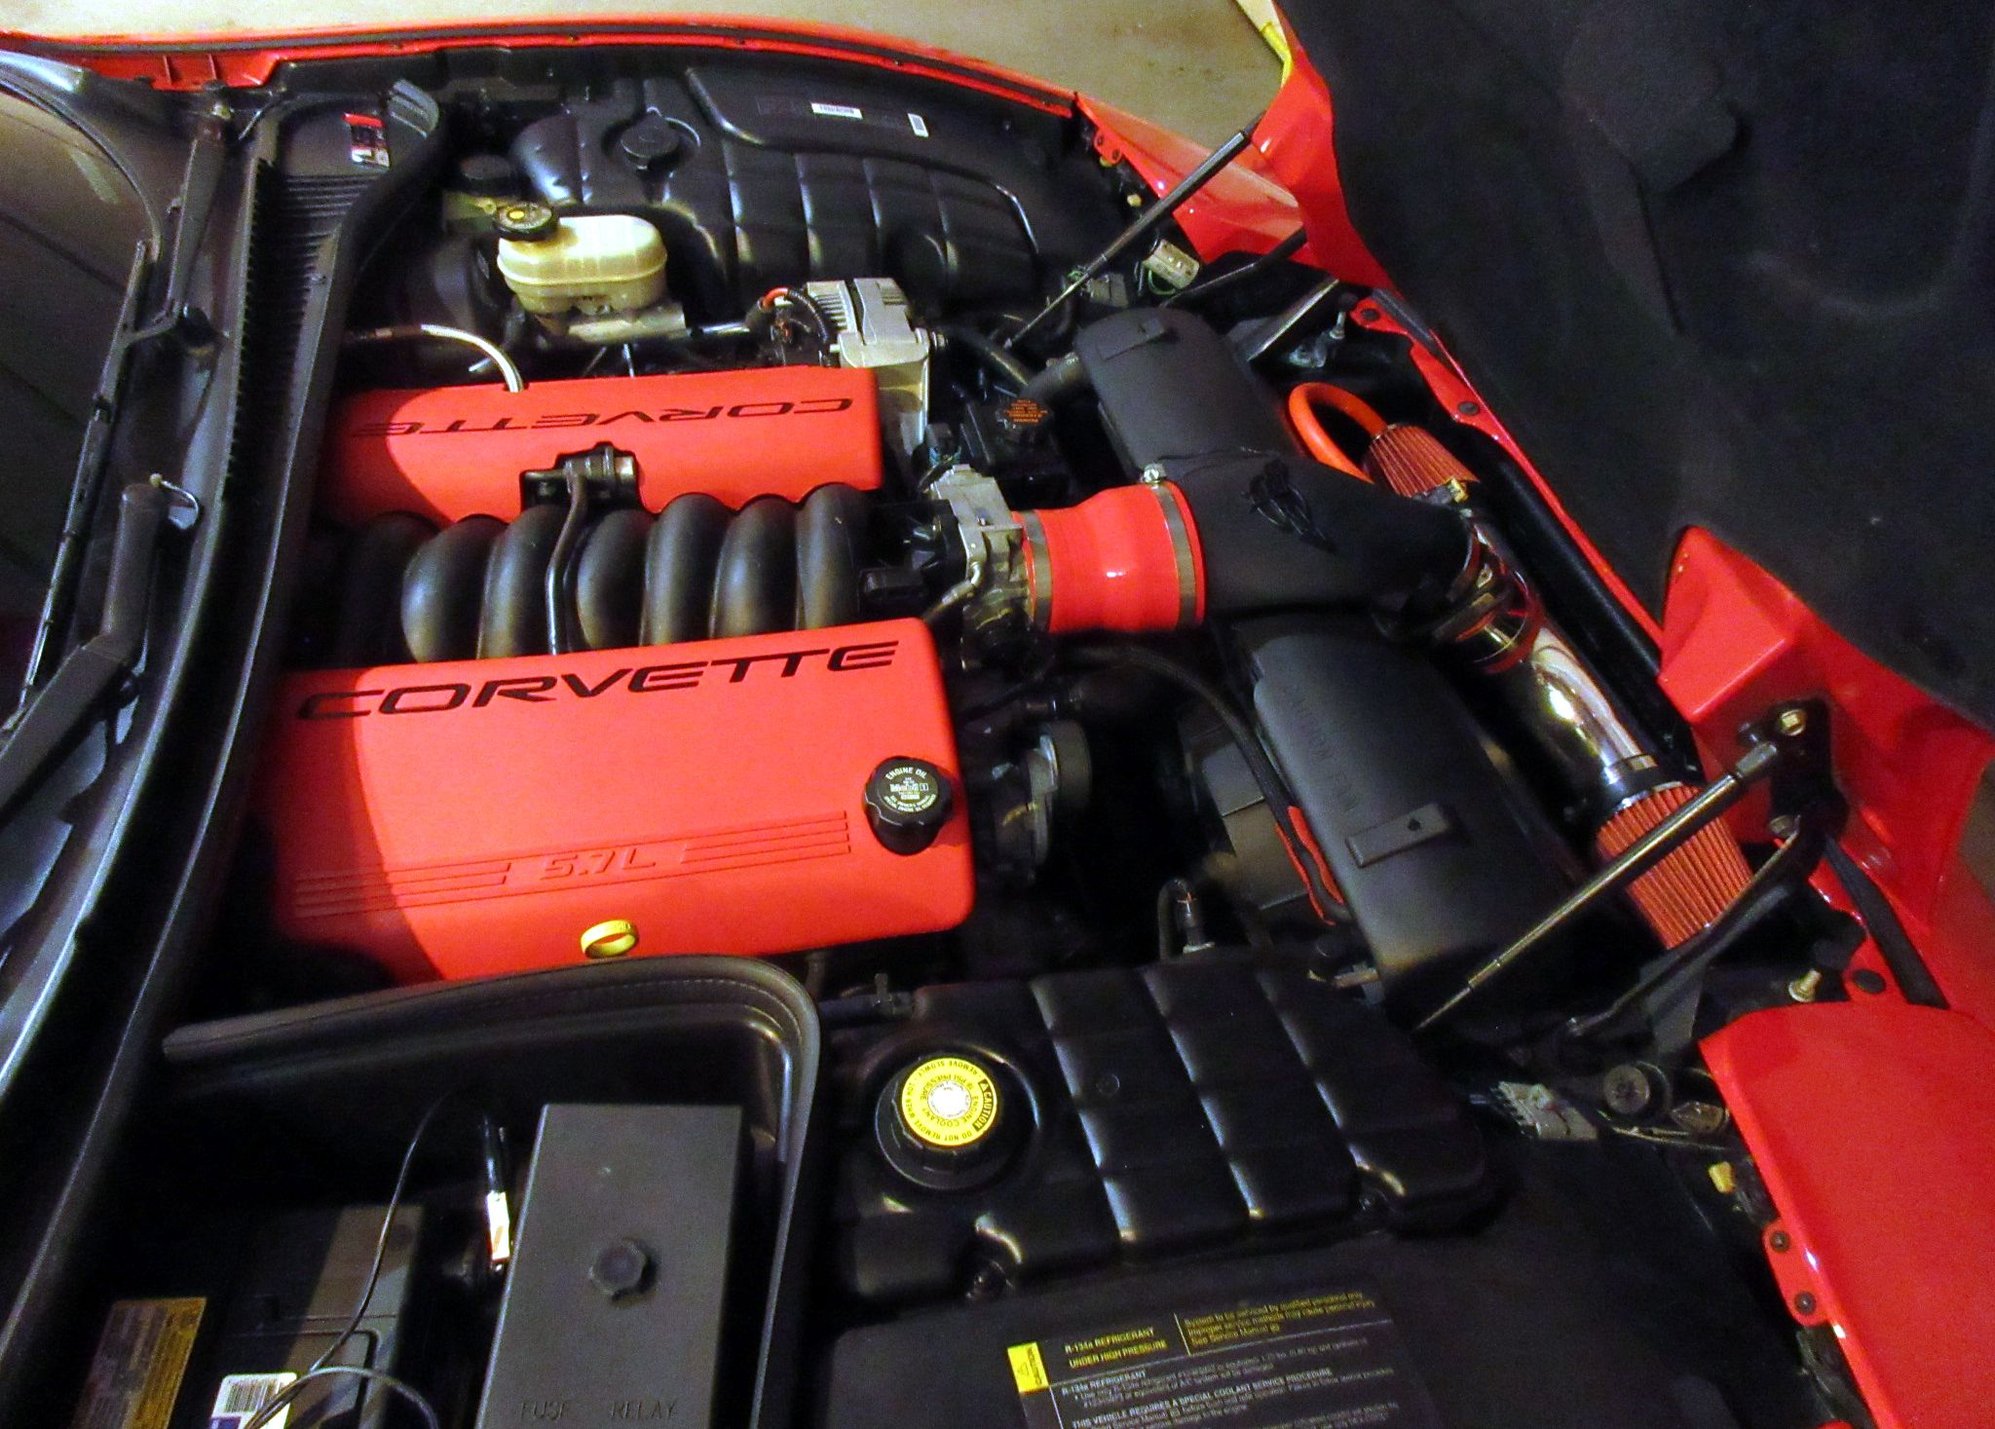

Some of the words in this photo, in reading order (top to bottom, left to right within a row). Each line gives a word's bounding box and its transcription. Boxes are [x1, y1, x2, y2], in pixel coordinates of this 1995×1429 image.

[353, 399, 853, 436] CORVETTE
[300, 641, 898, 719] CORVETTE
[885, 766, 914, 780] ENGINE
[915, 768, 928, 779] OIL
[540, 847, 657, 881] 5.7L
[948, 1060, 977, 1075] REMOVE
[974, 1091, 992, 1129] CAUTION
[914, 1120, 940, 1139] REMOVE
[961, 1131, 972, 1139] DO
